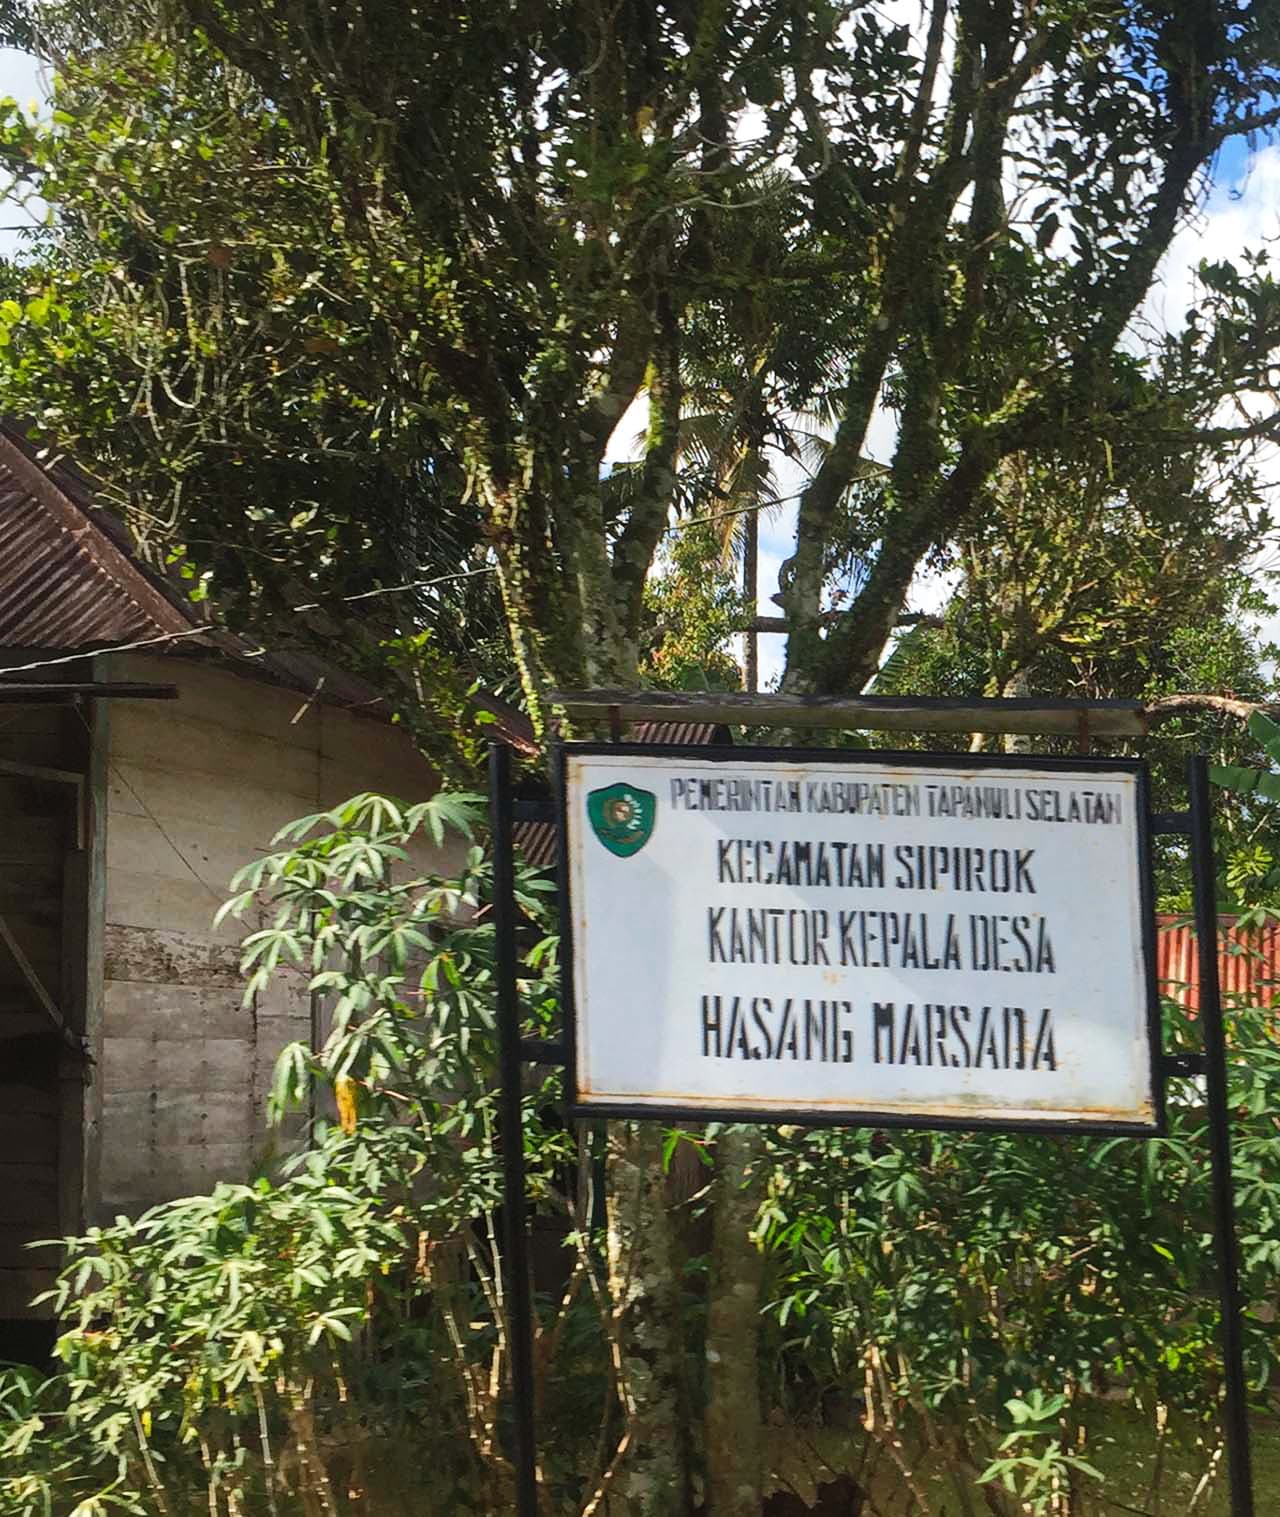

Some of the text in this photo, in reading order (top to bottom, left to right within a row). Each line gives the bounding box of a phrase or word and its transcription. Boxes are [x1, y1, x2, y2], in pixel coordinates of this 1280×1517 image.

[668, 777, 1124, 825] PEMERINTAH KABUPATEN TAPANULI SELATAN
[717, 839, 1038, 894] KECAMATAN SIPIROK
[707, 906, 1056, 974] KANTOR KEPALA DESA
[700, 995, 1057, 1072] HASANG MARSADA
